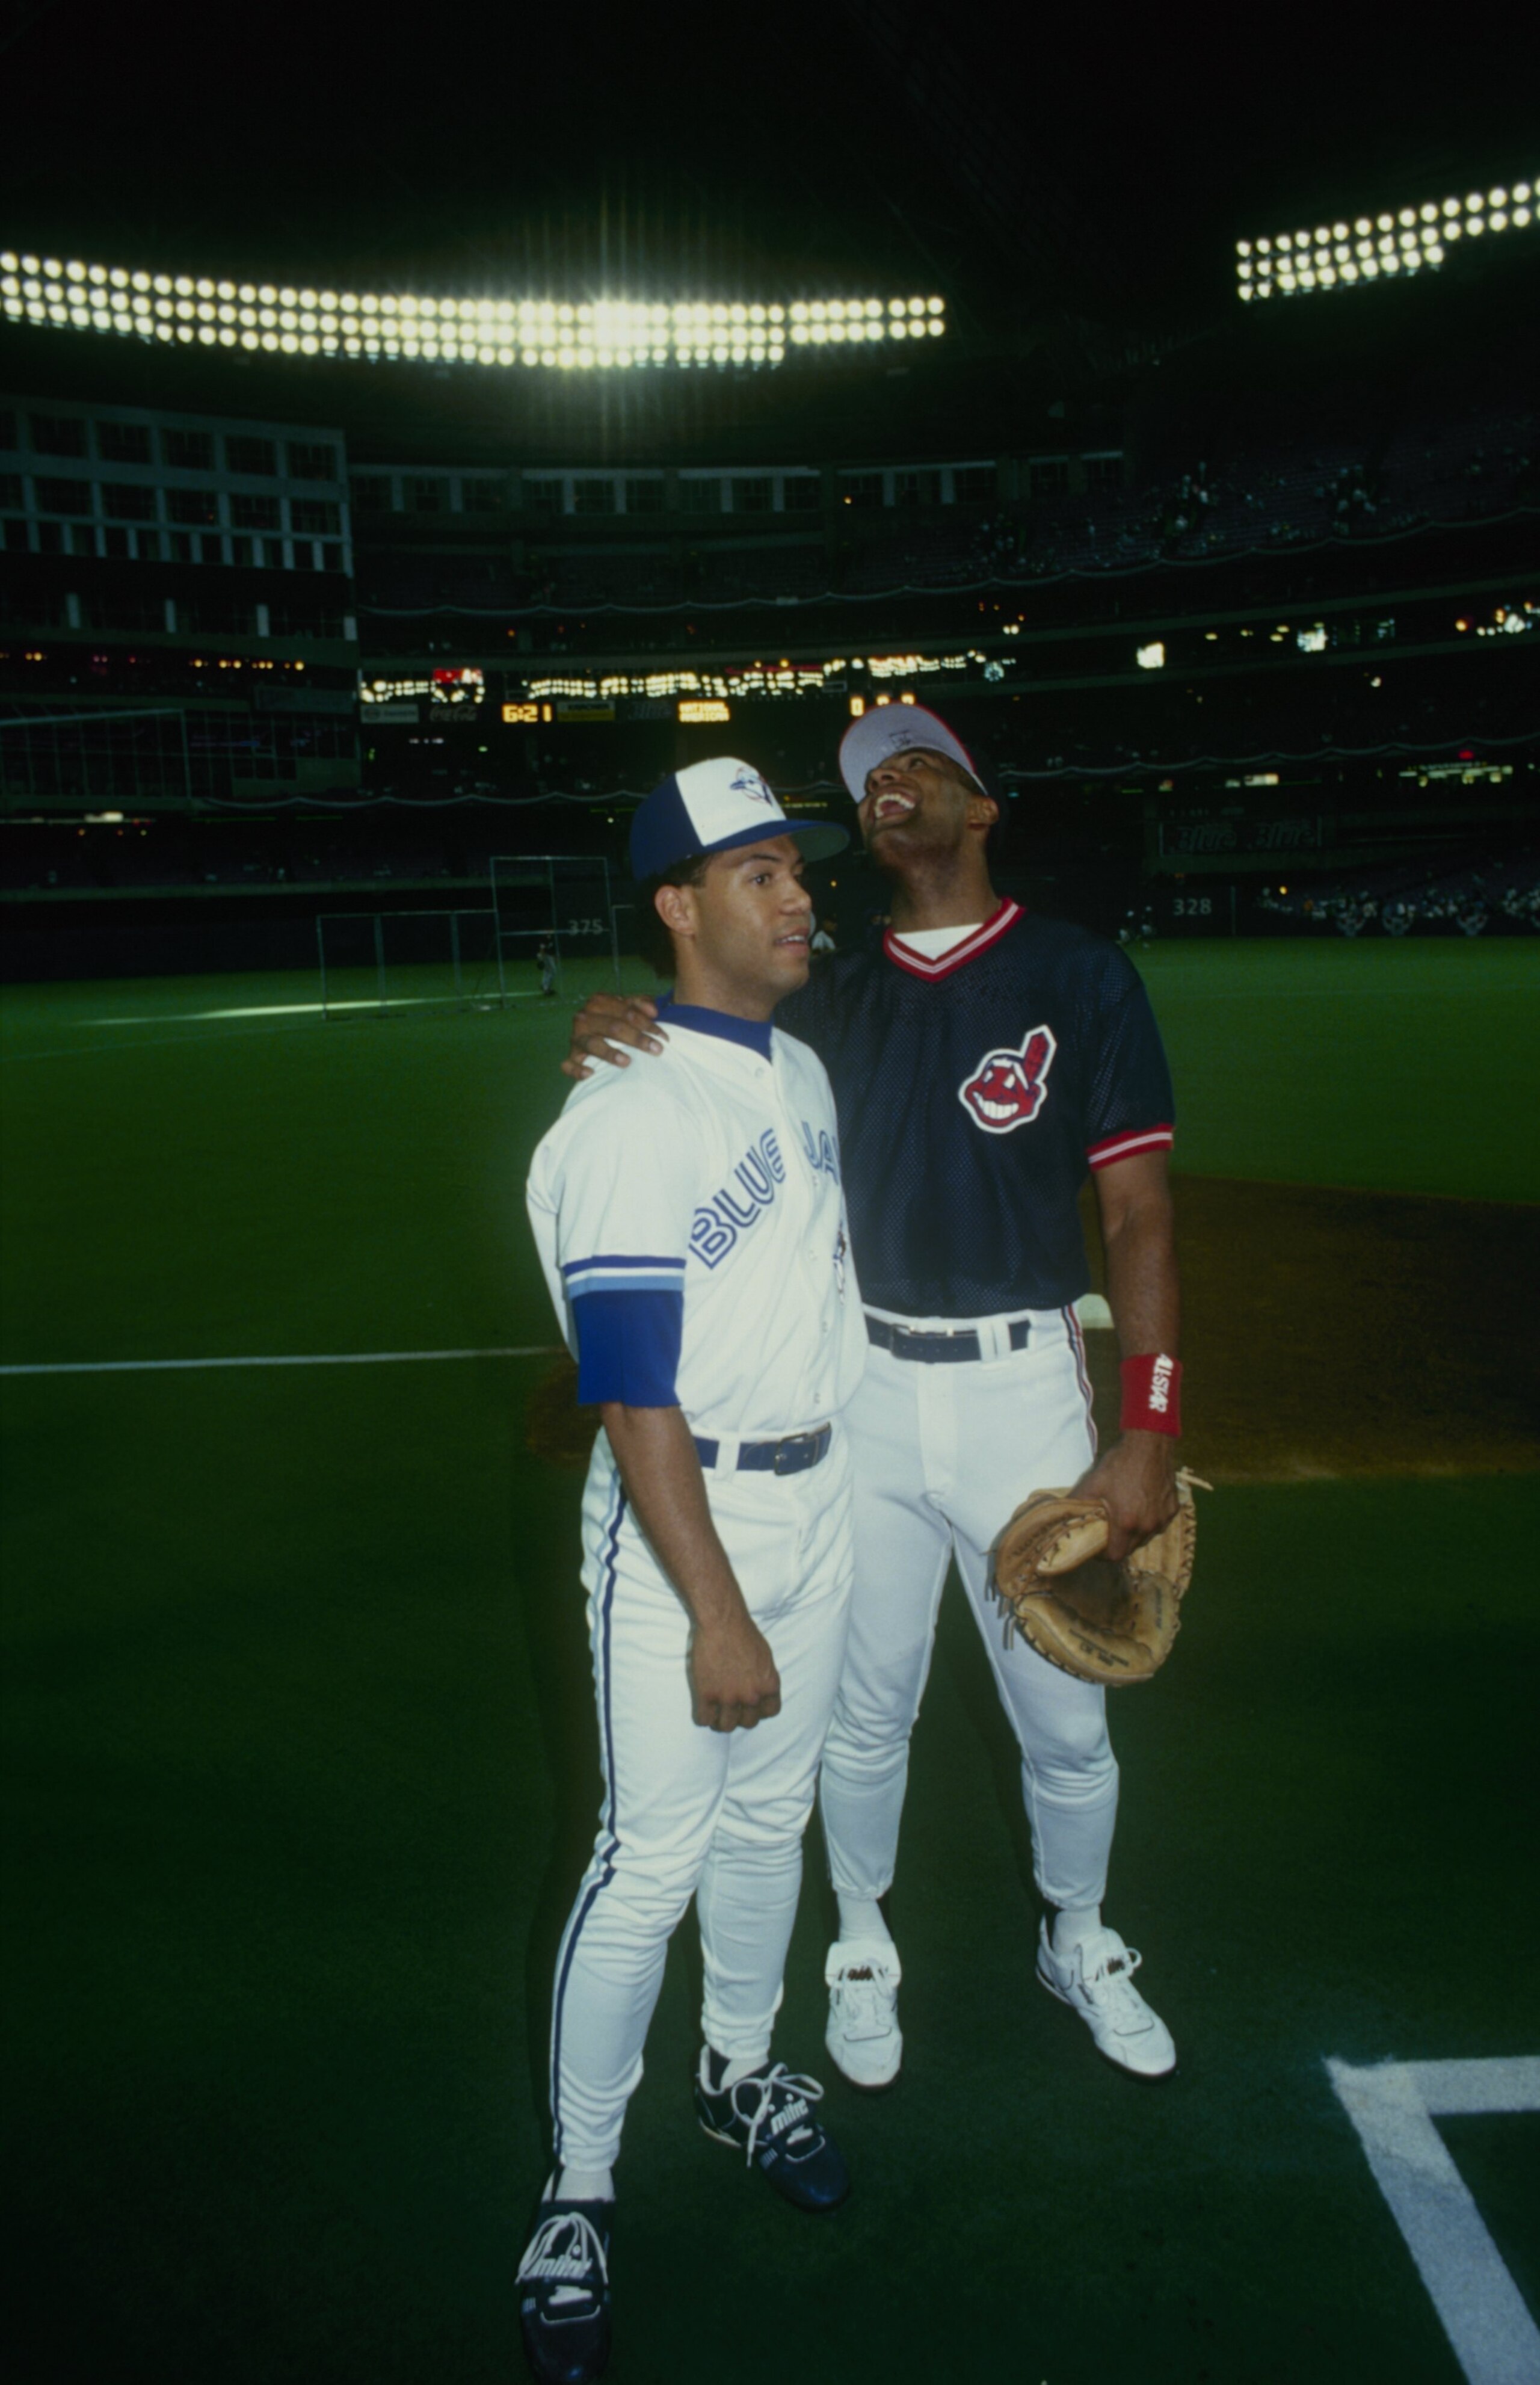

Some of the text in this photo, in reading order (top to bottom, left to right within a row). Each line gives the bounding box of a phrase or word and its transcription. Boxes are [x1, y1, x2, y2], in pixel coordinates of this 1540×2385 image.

[501, 703, 553, 723] 6:21
[1172, 898, 1212, 916] 328
[568, 919, 603, 935] 375
[689, 1120, 841, 1270] BLUE JA
